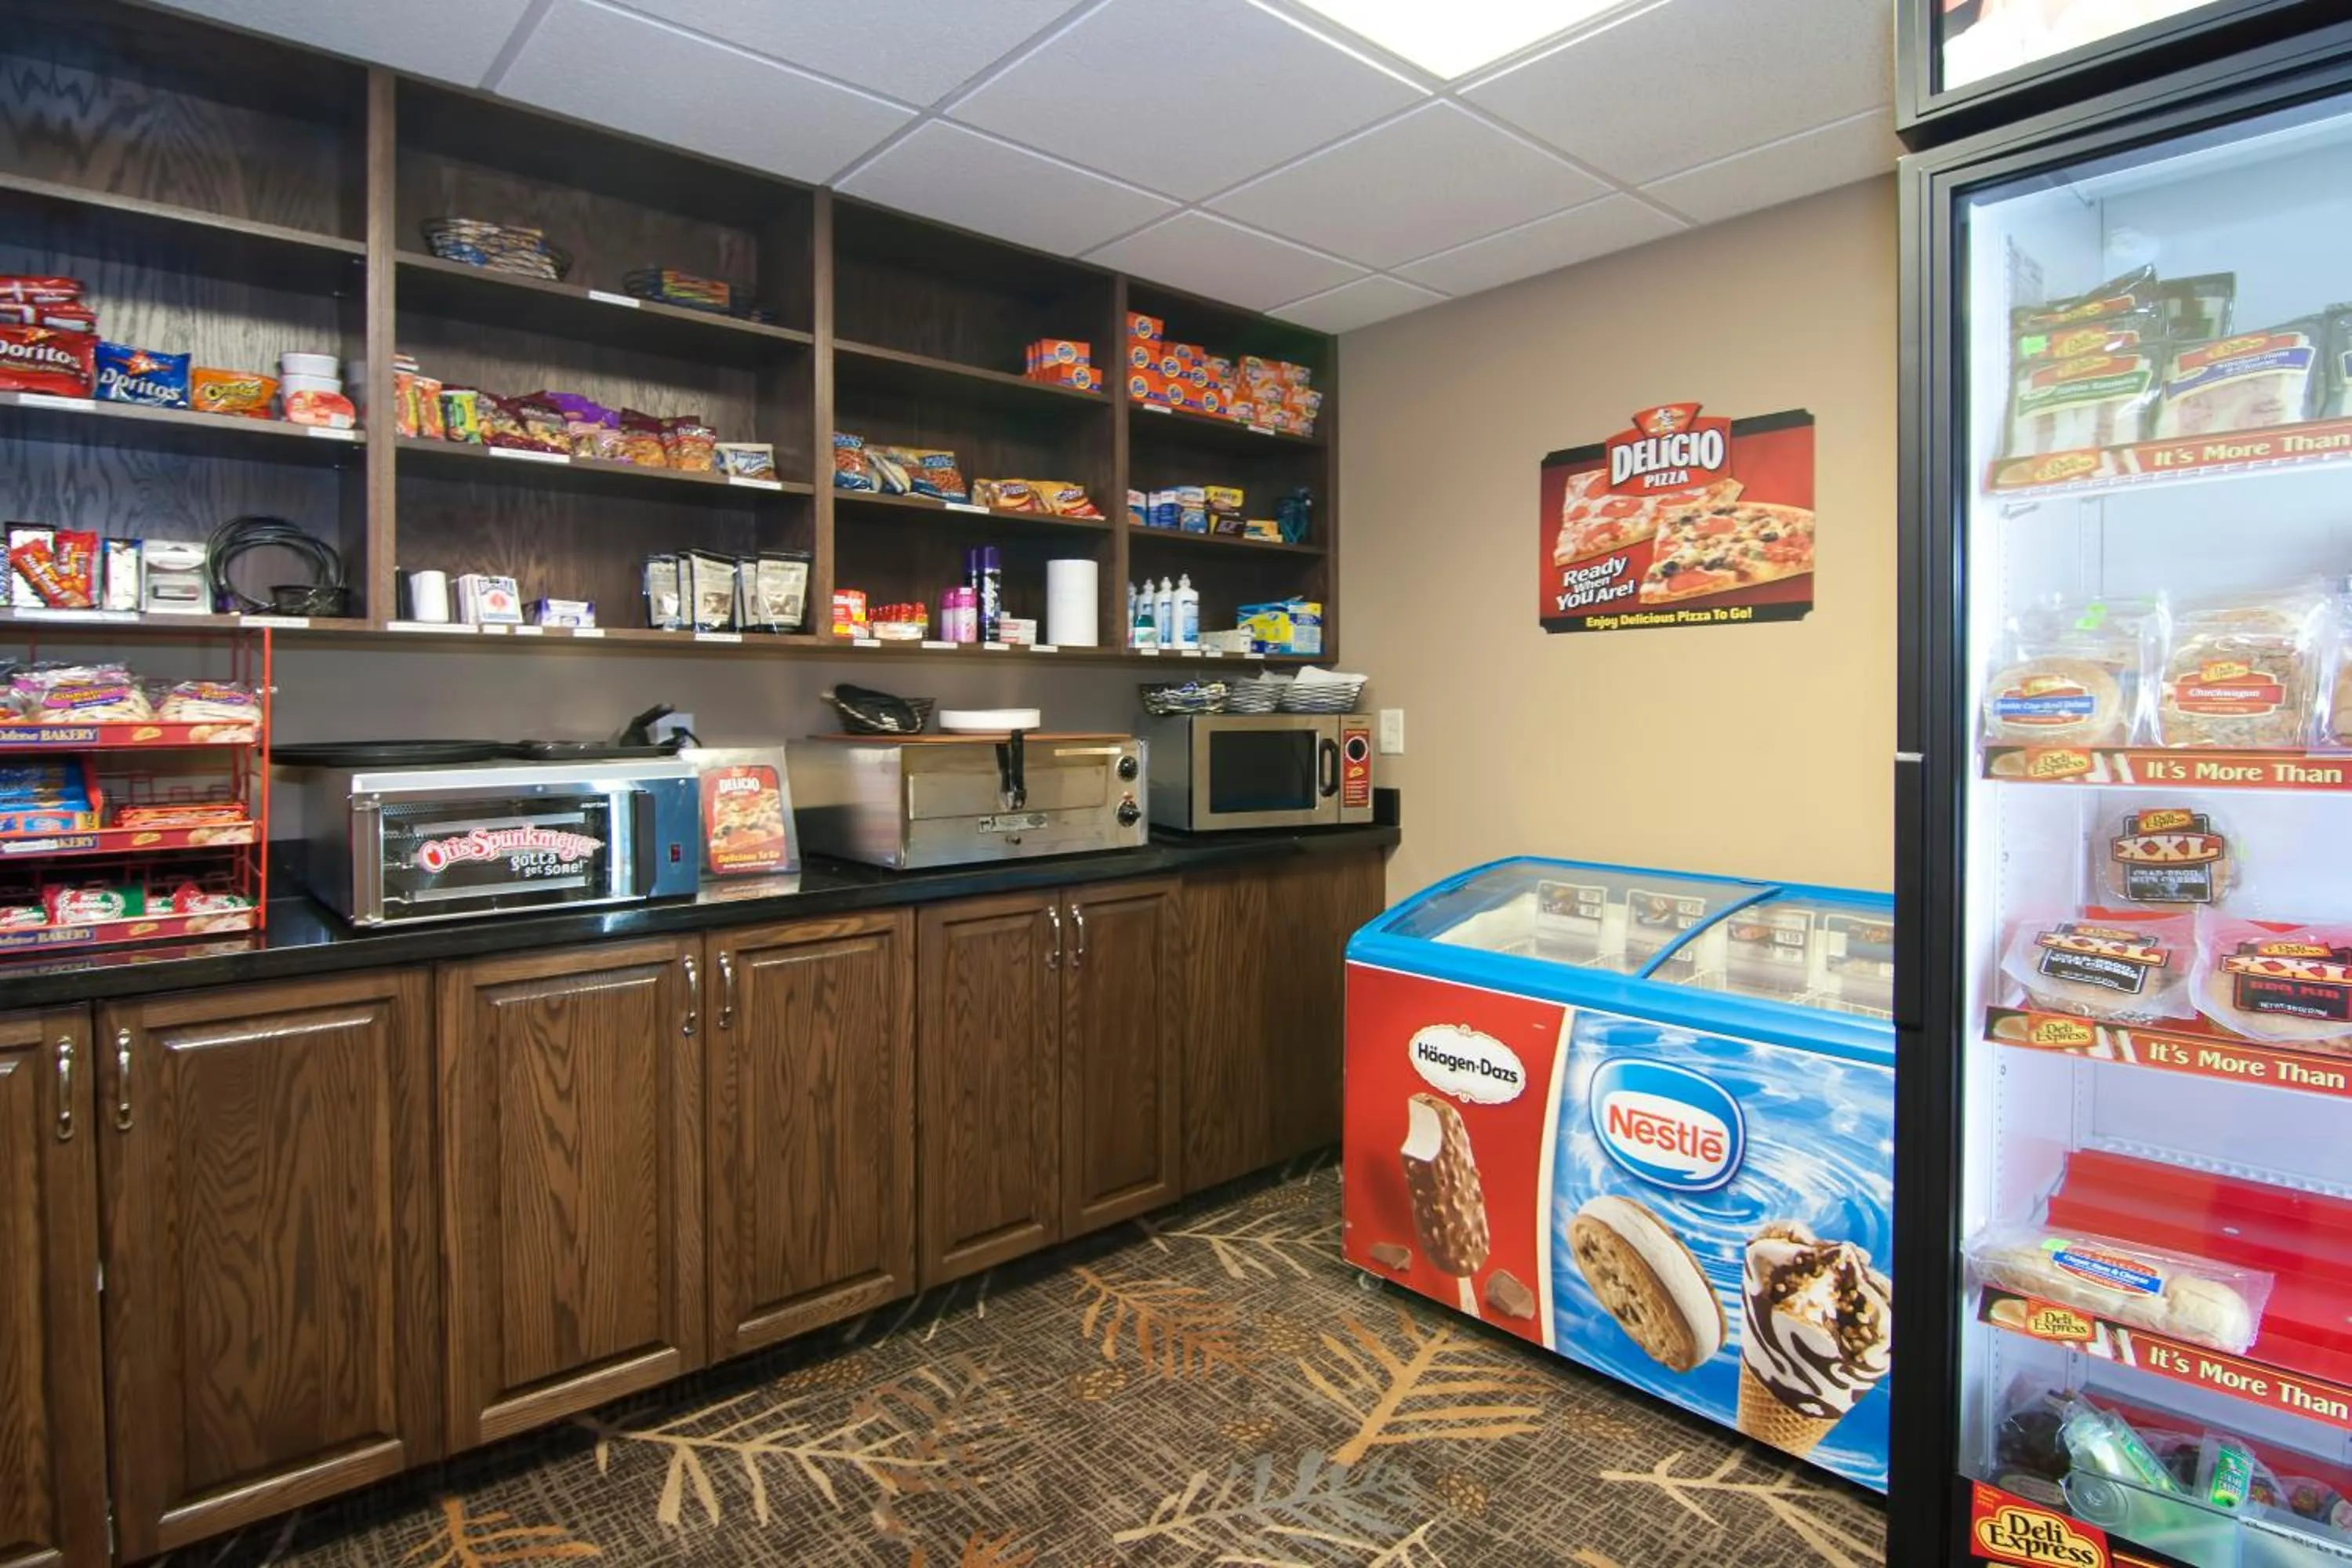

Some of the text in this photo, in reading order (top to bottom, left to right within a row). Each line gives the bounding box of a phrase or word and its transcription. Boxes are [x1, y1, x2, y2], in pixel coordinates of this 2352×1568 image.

[100, 367, 180, 401] Doritos
[2153, 433, 2350, 466] It's More Than
[1643, 470, 1690, 488] PIZZA
[1563, 555, 1628, 587] Ready
[1573, 576, 1610, 593] When
[1595, 579, 1635, 604] Are!
[1585, 607, 1753, 630] Enjoy Delicious Pizza To Go!
[41, 728, 96, 741] BAKERY
[2146, 760, 2343, 783] It's More Than
[418, 822, 602, 873] Otis Spunkmeyer
[2117, 834, 2221, 862] XXL
[511, 852, 557, 872] gotta
[524, 859, 584, 877] get some!
[2035, 1030, 2089, 1044] Express
[2045, 1023, 2073, 1034] Deli
[2148, 1042, 2345, 1089] It's More Than
[2034, 1319, 2087, 1335] Express
[2044, 1311, 2074, 1326] Deli
[2148, 1345, 2350, 1420] It's More Than
[2006, 1512, 2063, 1544] Deli
[1988, 1523, 2096, 1566] Express
